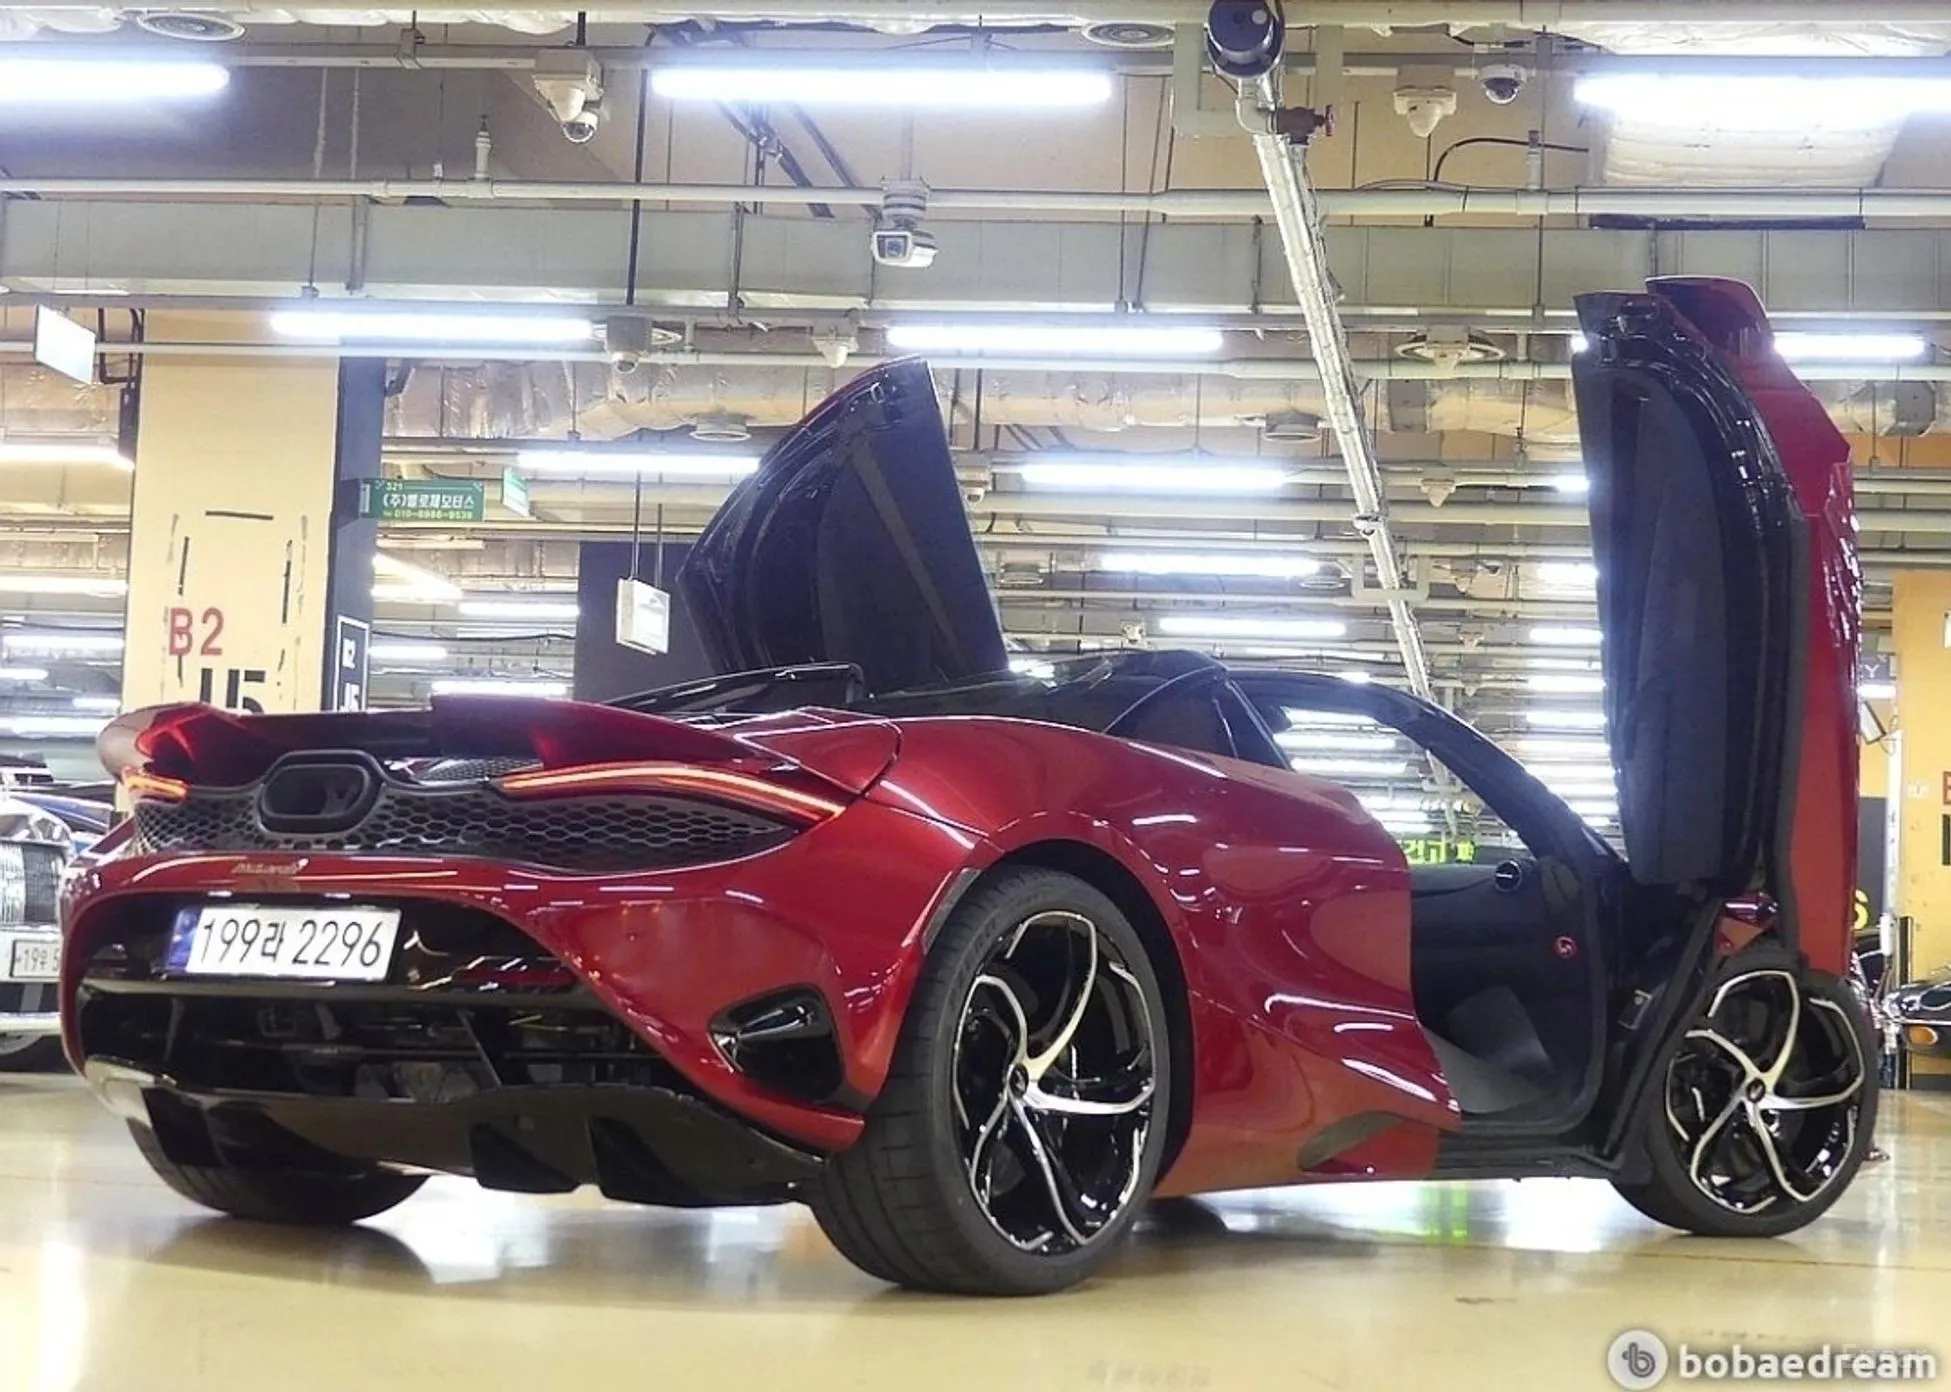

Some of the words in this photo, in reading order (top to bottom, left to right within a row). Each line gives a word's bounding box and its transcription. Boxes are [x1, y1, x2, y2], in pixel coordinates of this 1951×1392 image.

[168, 606, 225, 656] B2
[201, 917, 286, 963] 199라
[291, 918, 384, 968] 2296
